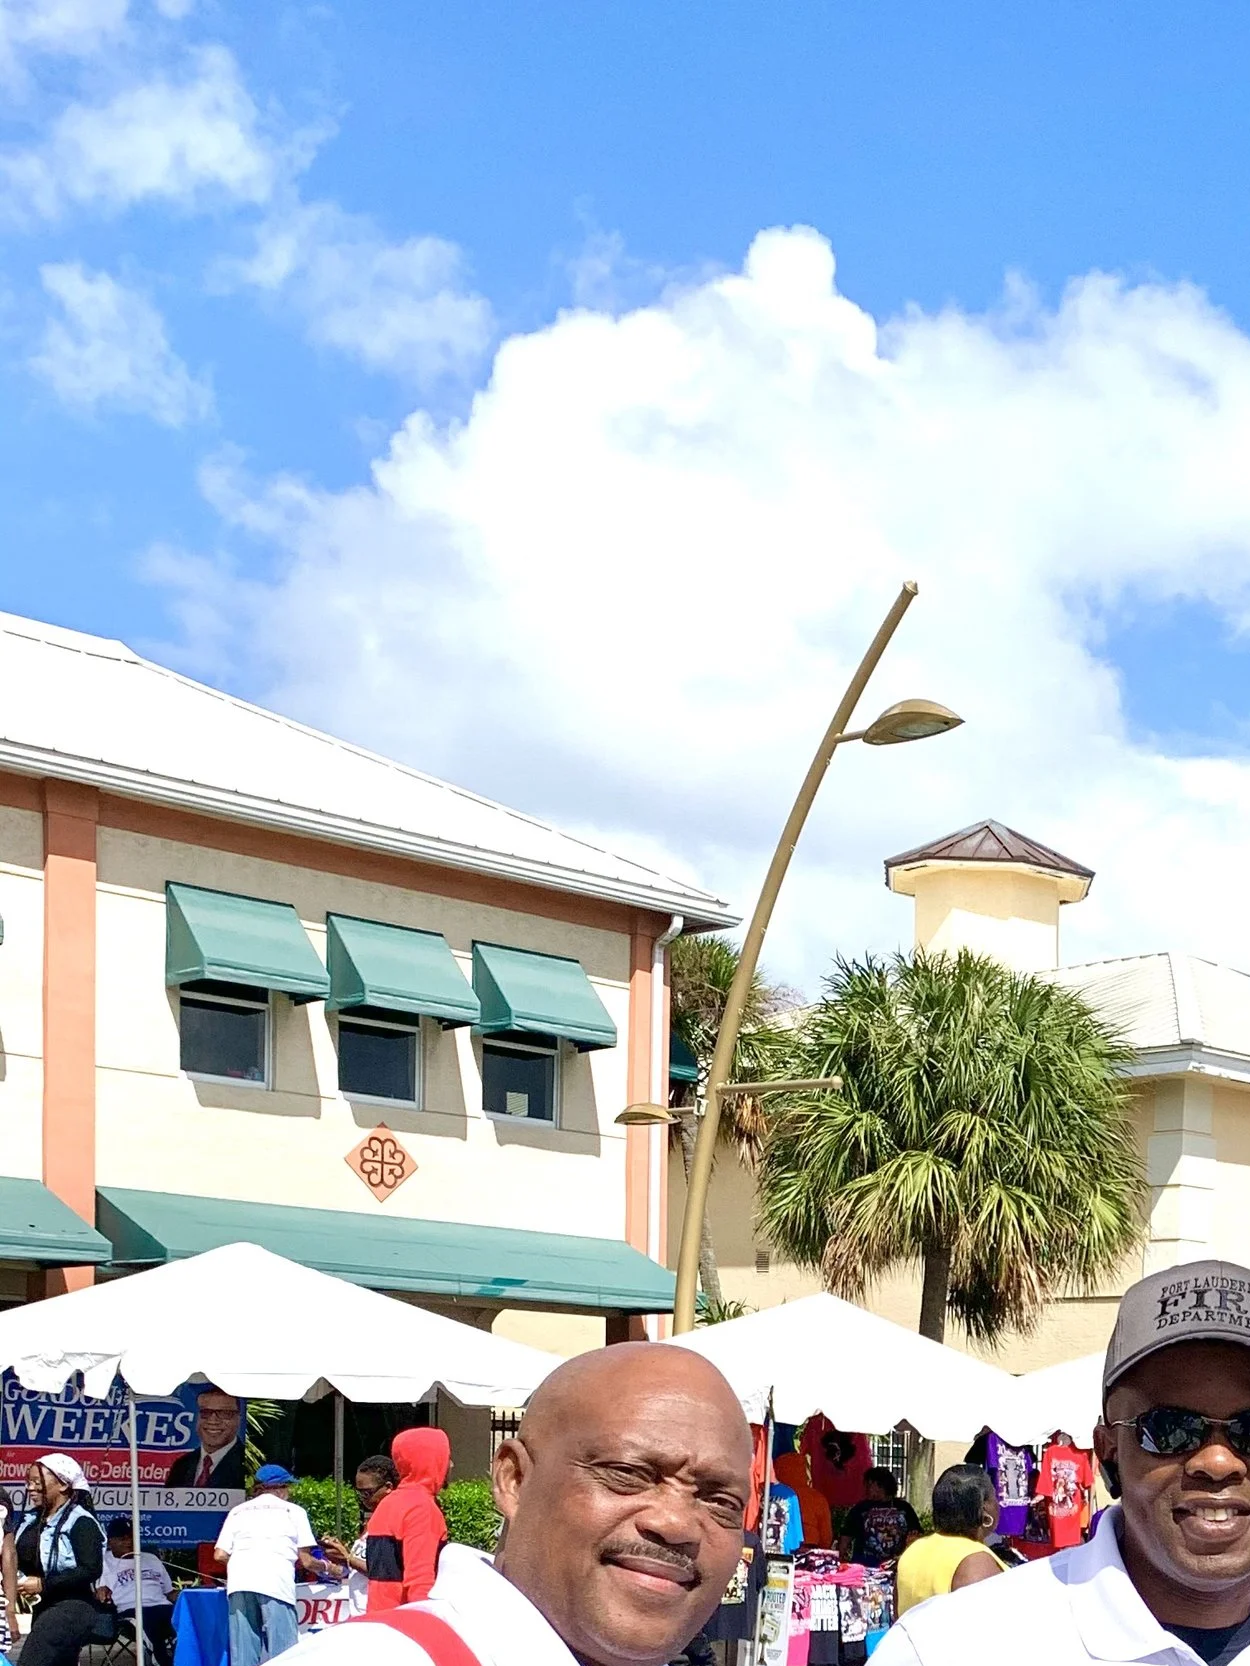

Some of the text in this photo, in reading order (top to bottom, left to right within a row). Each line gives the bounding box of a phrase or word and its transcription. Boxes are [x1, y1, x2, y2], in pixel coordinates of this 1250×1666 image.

[4, 1403, 194, 1446] WEEKES
[155, 1491, 180, 1509] 18,
[184, 1491, 229, 1507] 2020
